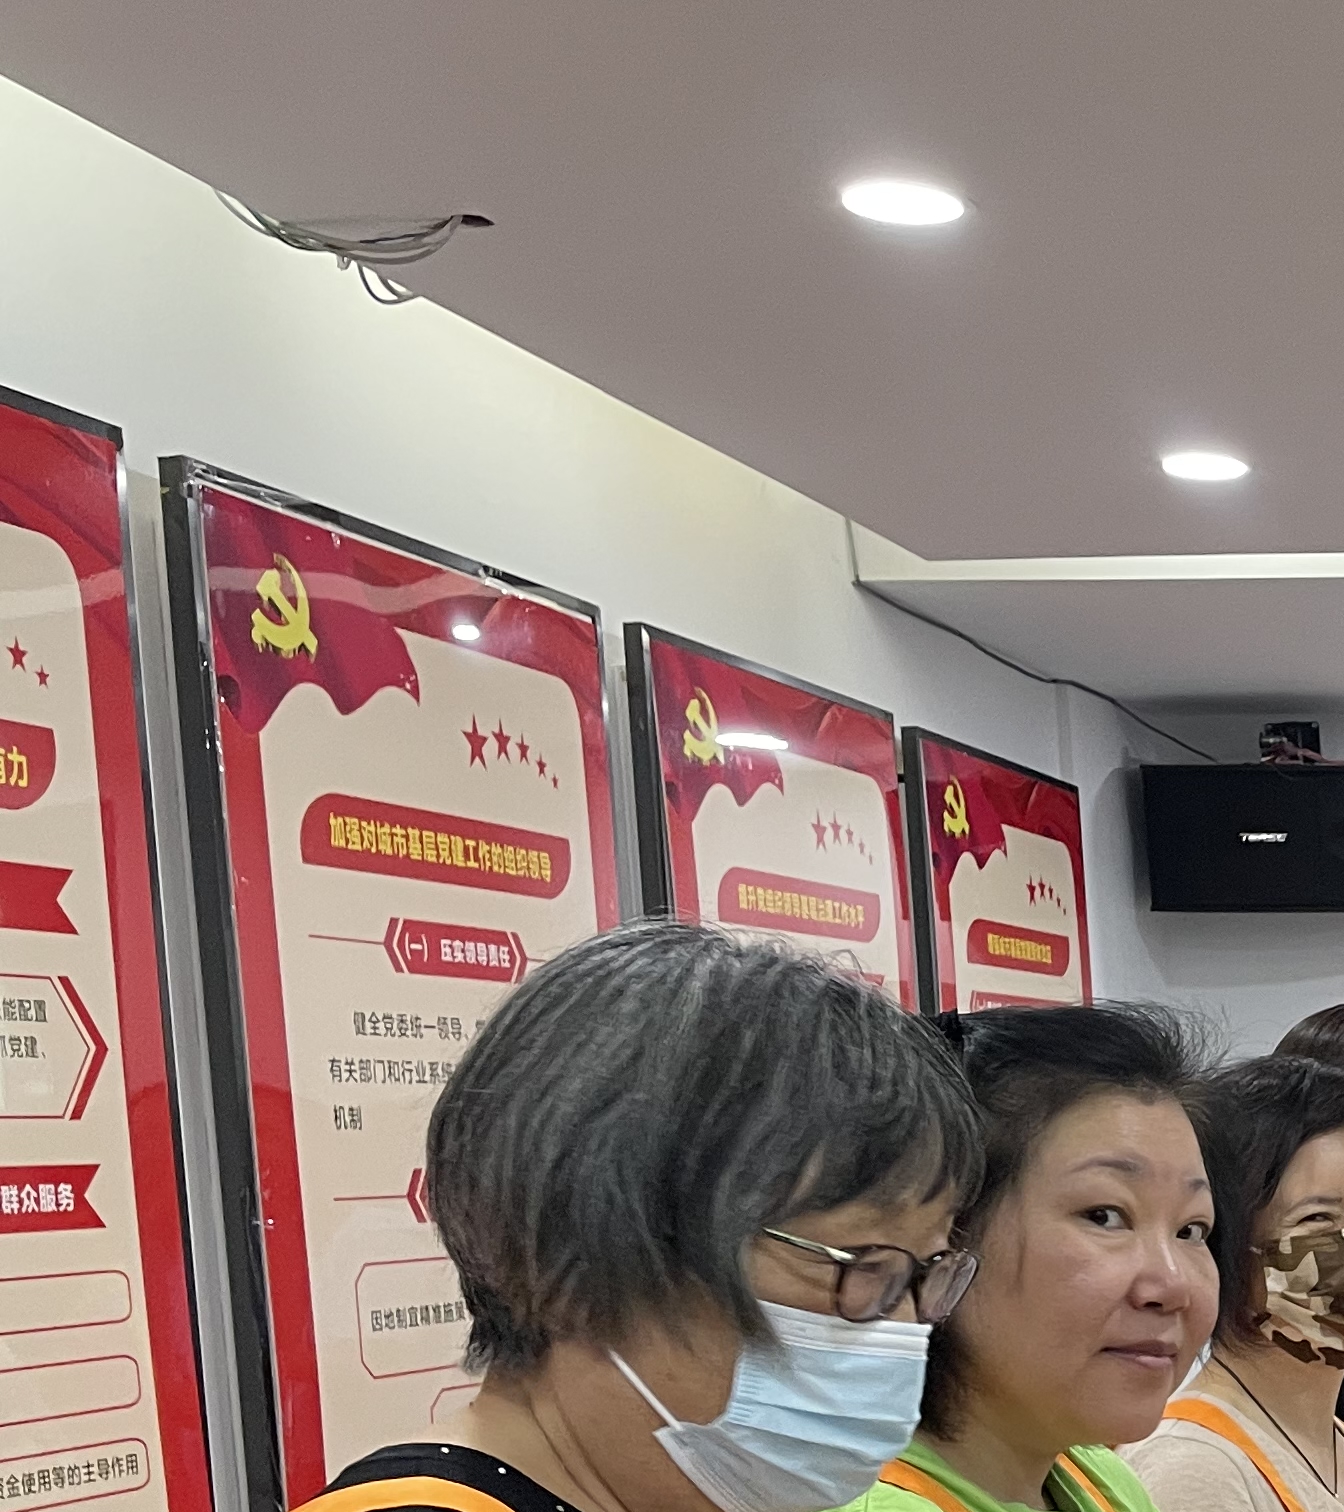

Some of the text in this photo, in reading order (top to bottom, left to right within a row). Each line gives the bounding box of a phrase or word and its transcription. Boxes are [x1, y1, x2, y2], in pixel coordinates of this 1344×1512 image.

[329, 812, 551, 882] 加强对城市基层党建工作的组织领导
[440, 939, 511, 968] 压实领导责任
[0, 998, 48, 1023] 能配置
[333, 1104, 363, 1131] 机制
